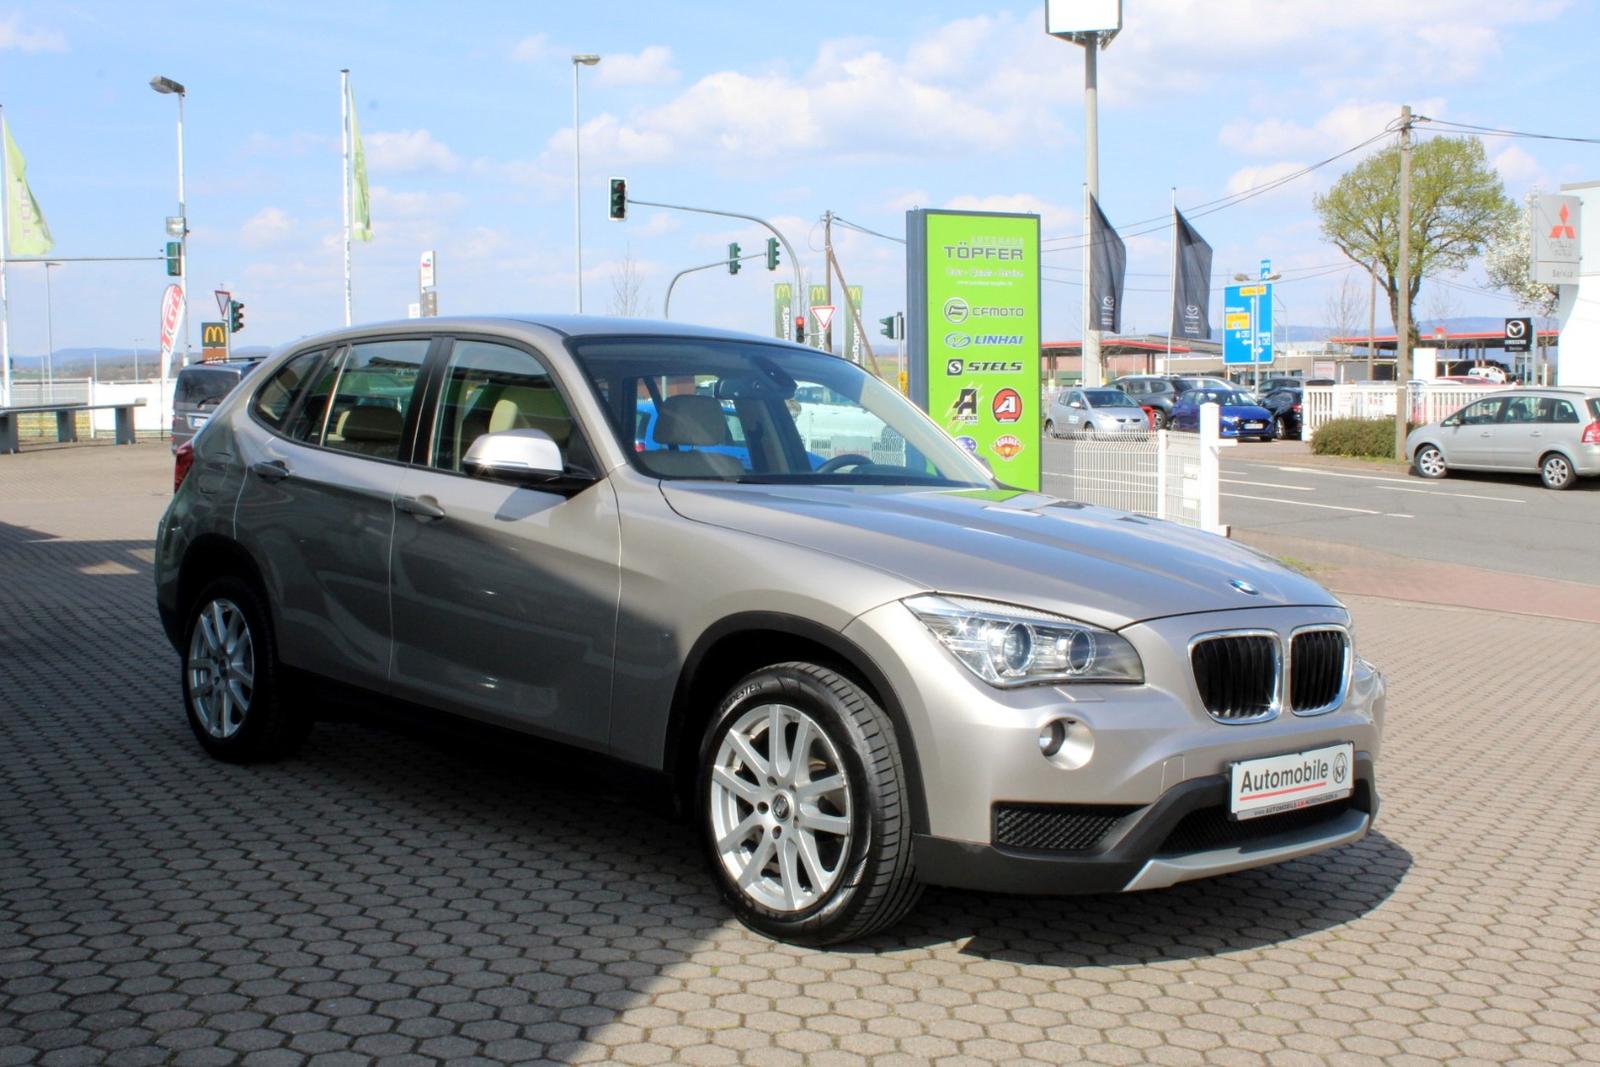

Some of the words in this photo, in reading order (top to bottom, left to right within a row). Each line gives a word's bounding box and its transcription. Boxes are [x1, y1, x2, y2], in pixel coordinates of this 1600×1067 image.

[944, 242, 1023, 261] TÖPFER
[972, 307, 1024, 317] CFMOTO
[974, 335, 1024, 345] LINHAI
[967, 362, 1023, 372] STELS
[1240, 759, 1329, 793] Automobile
